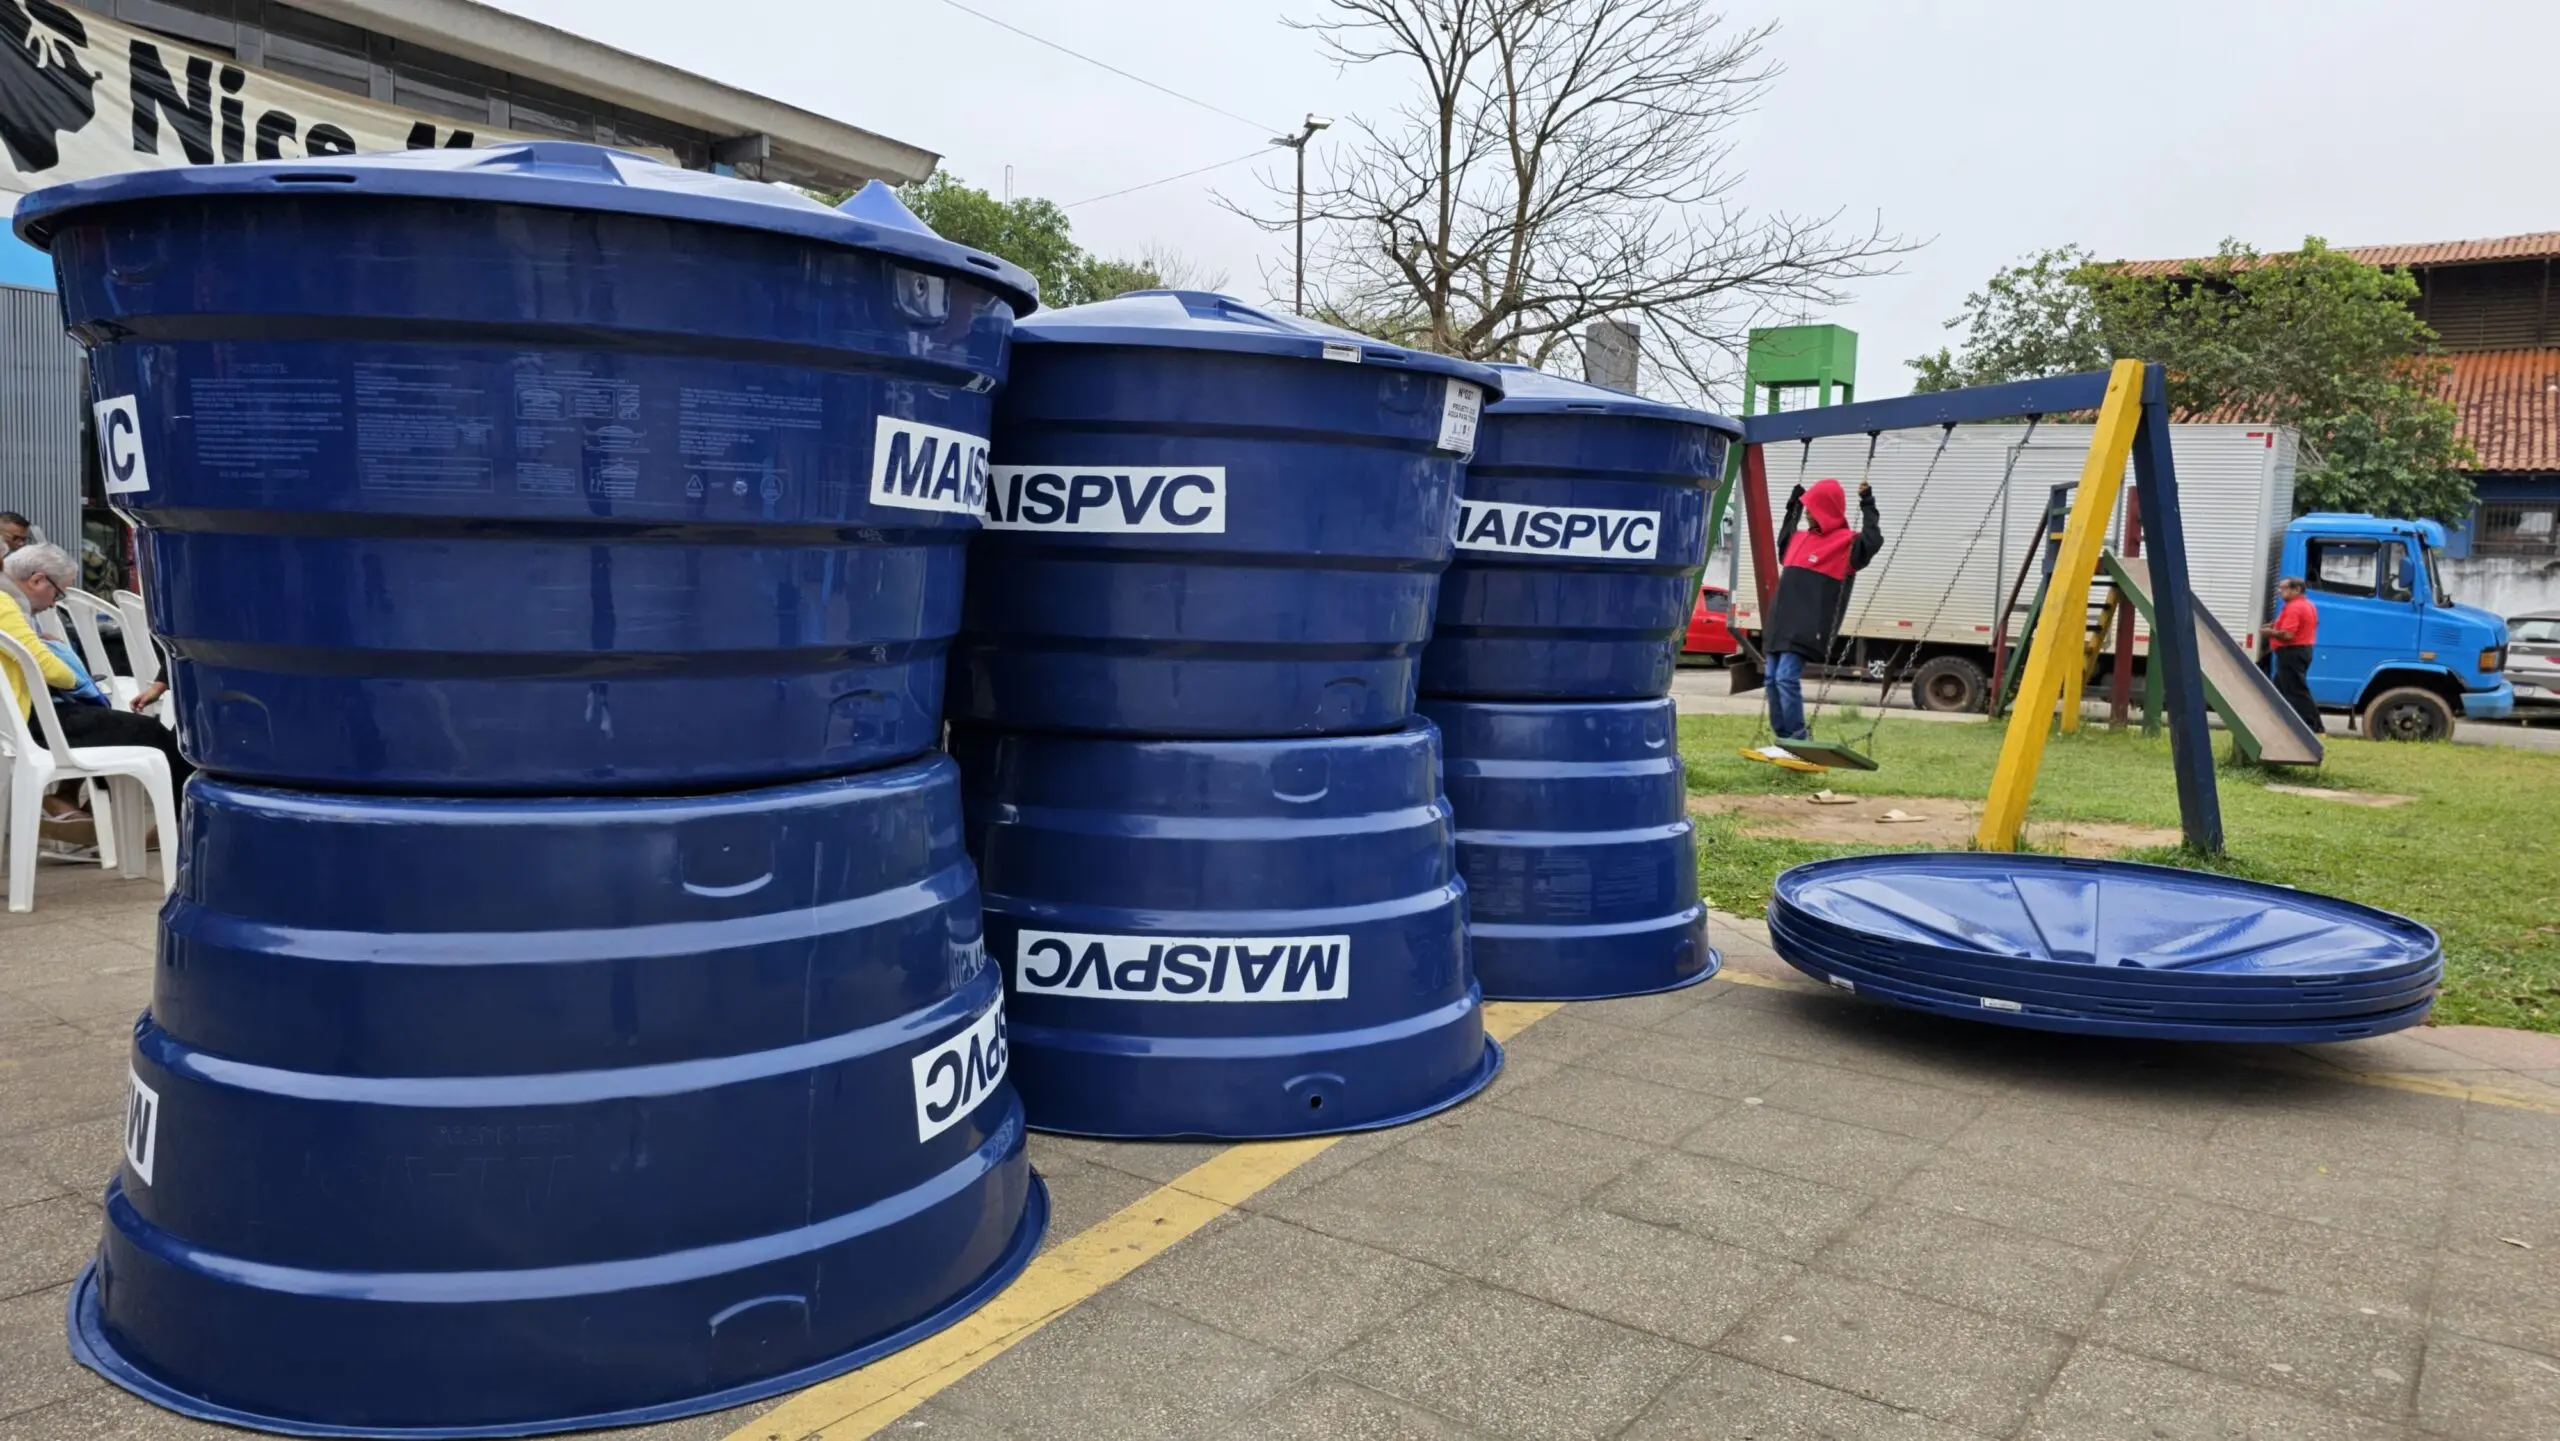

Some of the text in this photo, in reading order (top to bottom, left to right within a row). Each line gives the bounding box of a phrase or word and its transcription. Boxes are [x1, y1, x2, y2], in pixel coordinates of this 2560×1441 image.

[882, 431, 988, 506] MAIS
[1456, 506, 1654, 554] AISPVC
[1025, 938, 1341, 994] MAISPVC
